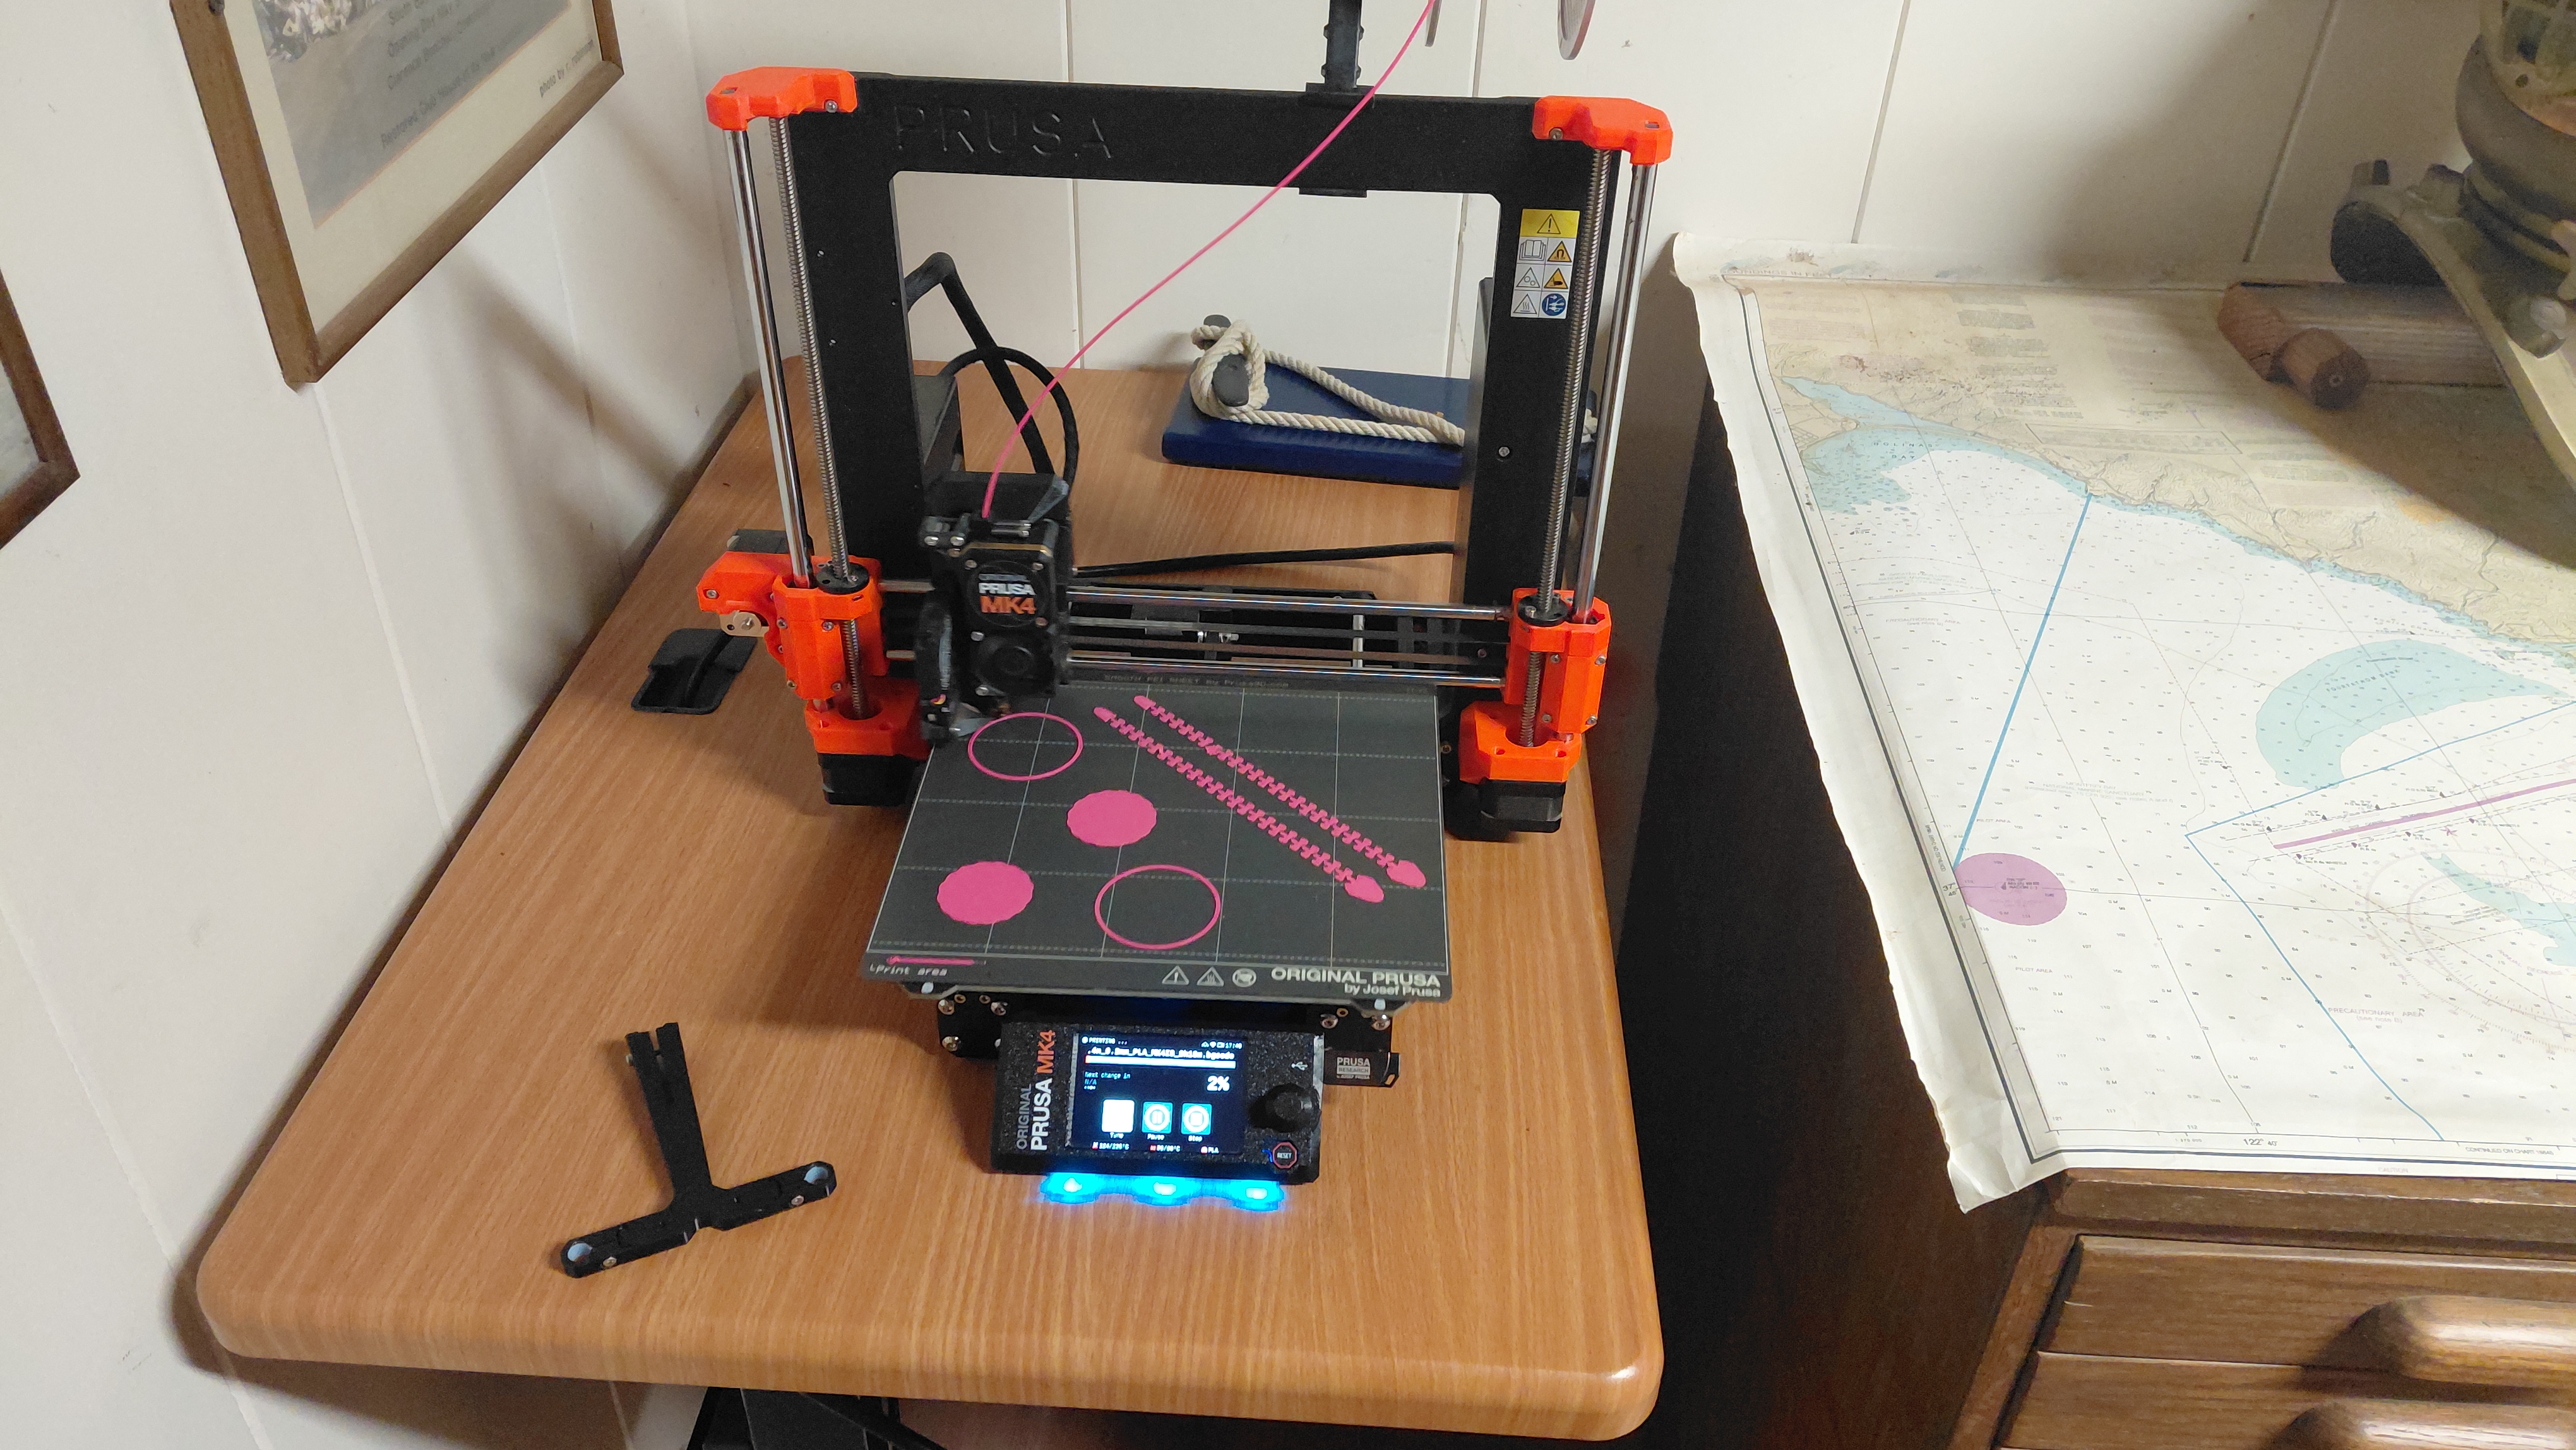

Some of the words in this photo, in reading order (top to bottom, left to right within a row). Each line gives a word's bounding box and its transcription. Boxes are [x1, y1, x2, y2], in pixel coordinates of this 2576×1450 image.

[540, 75, 556, 98] photo
[557, 68, 564, 80] by
[893, 105, 1112, 159] PRUSA
[979, 582, 1037, 596] PRUSA
[981, 596, 1037, 614] MK4
[1270, 966, 1368, 985] ORIGINAL
[1372, 971, 1441, 988] PRUSA
[1344, 983, 1361, 996] by
[1362, 983, 1400, 997] Josef
[1402, 985, 1441, 998] Prusa
[2328, 1007, 2395, 1017] PRECAUTIONARY
[2402, 1010, 2424, 1018] AREA
[1088, 1036, 1116, 1045] PRINTING
[1037, 1029, 1056, 1074] MK4
[1337, 1057, 1371, 1067] PRUSA
[1100, 1072, 1121, 1080] change
[1207, 1075, 1231, 1092] 2%
[1015, 1083, 1032, 1151] ORIGINAL
[1030, 1077, 1053, 1151] PRUSA
[1188, 1135, 1203, 1143] Stop
[2243, 1138, 2265, 1146] 122°
[1207, 1146, 1220, 1154] PLA
